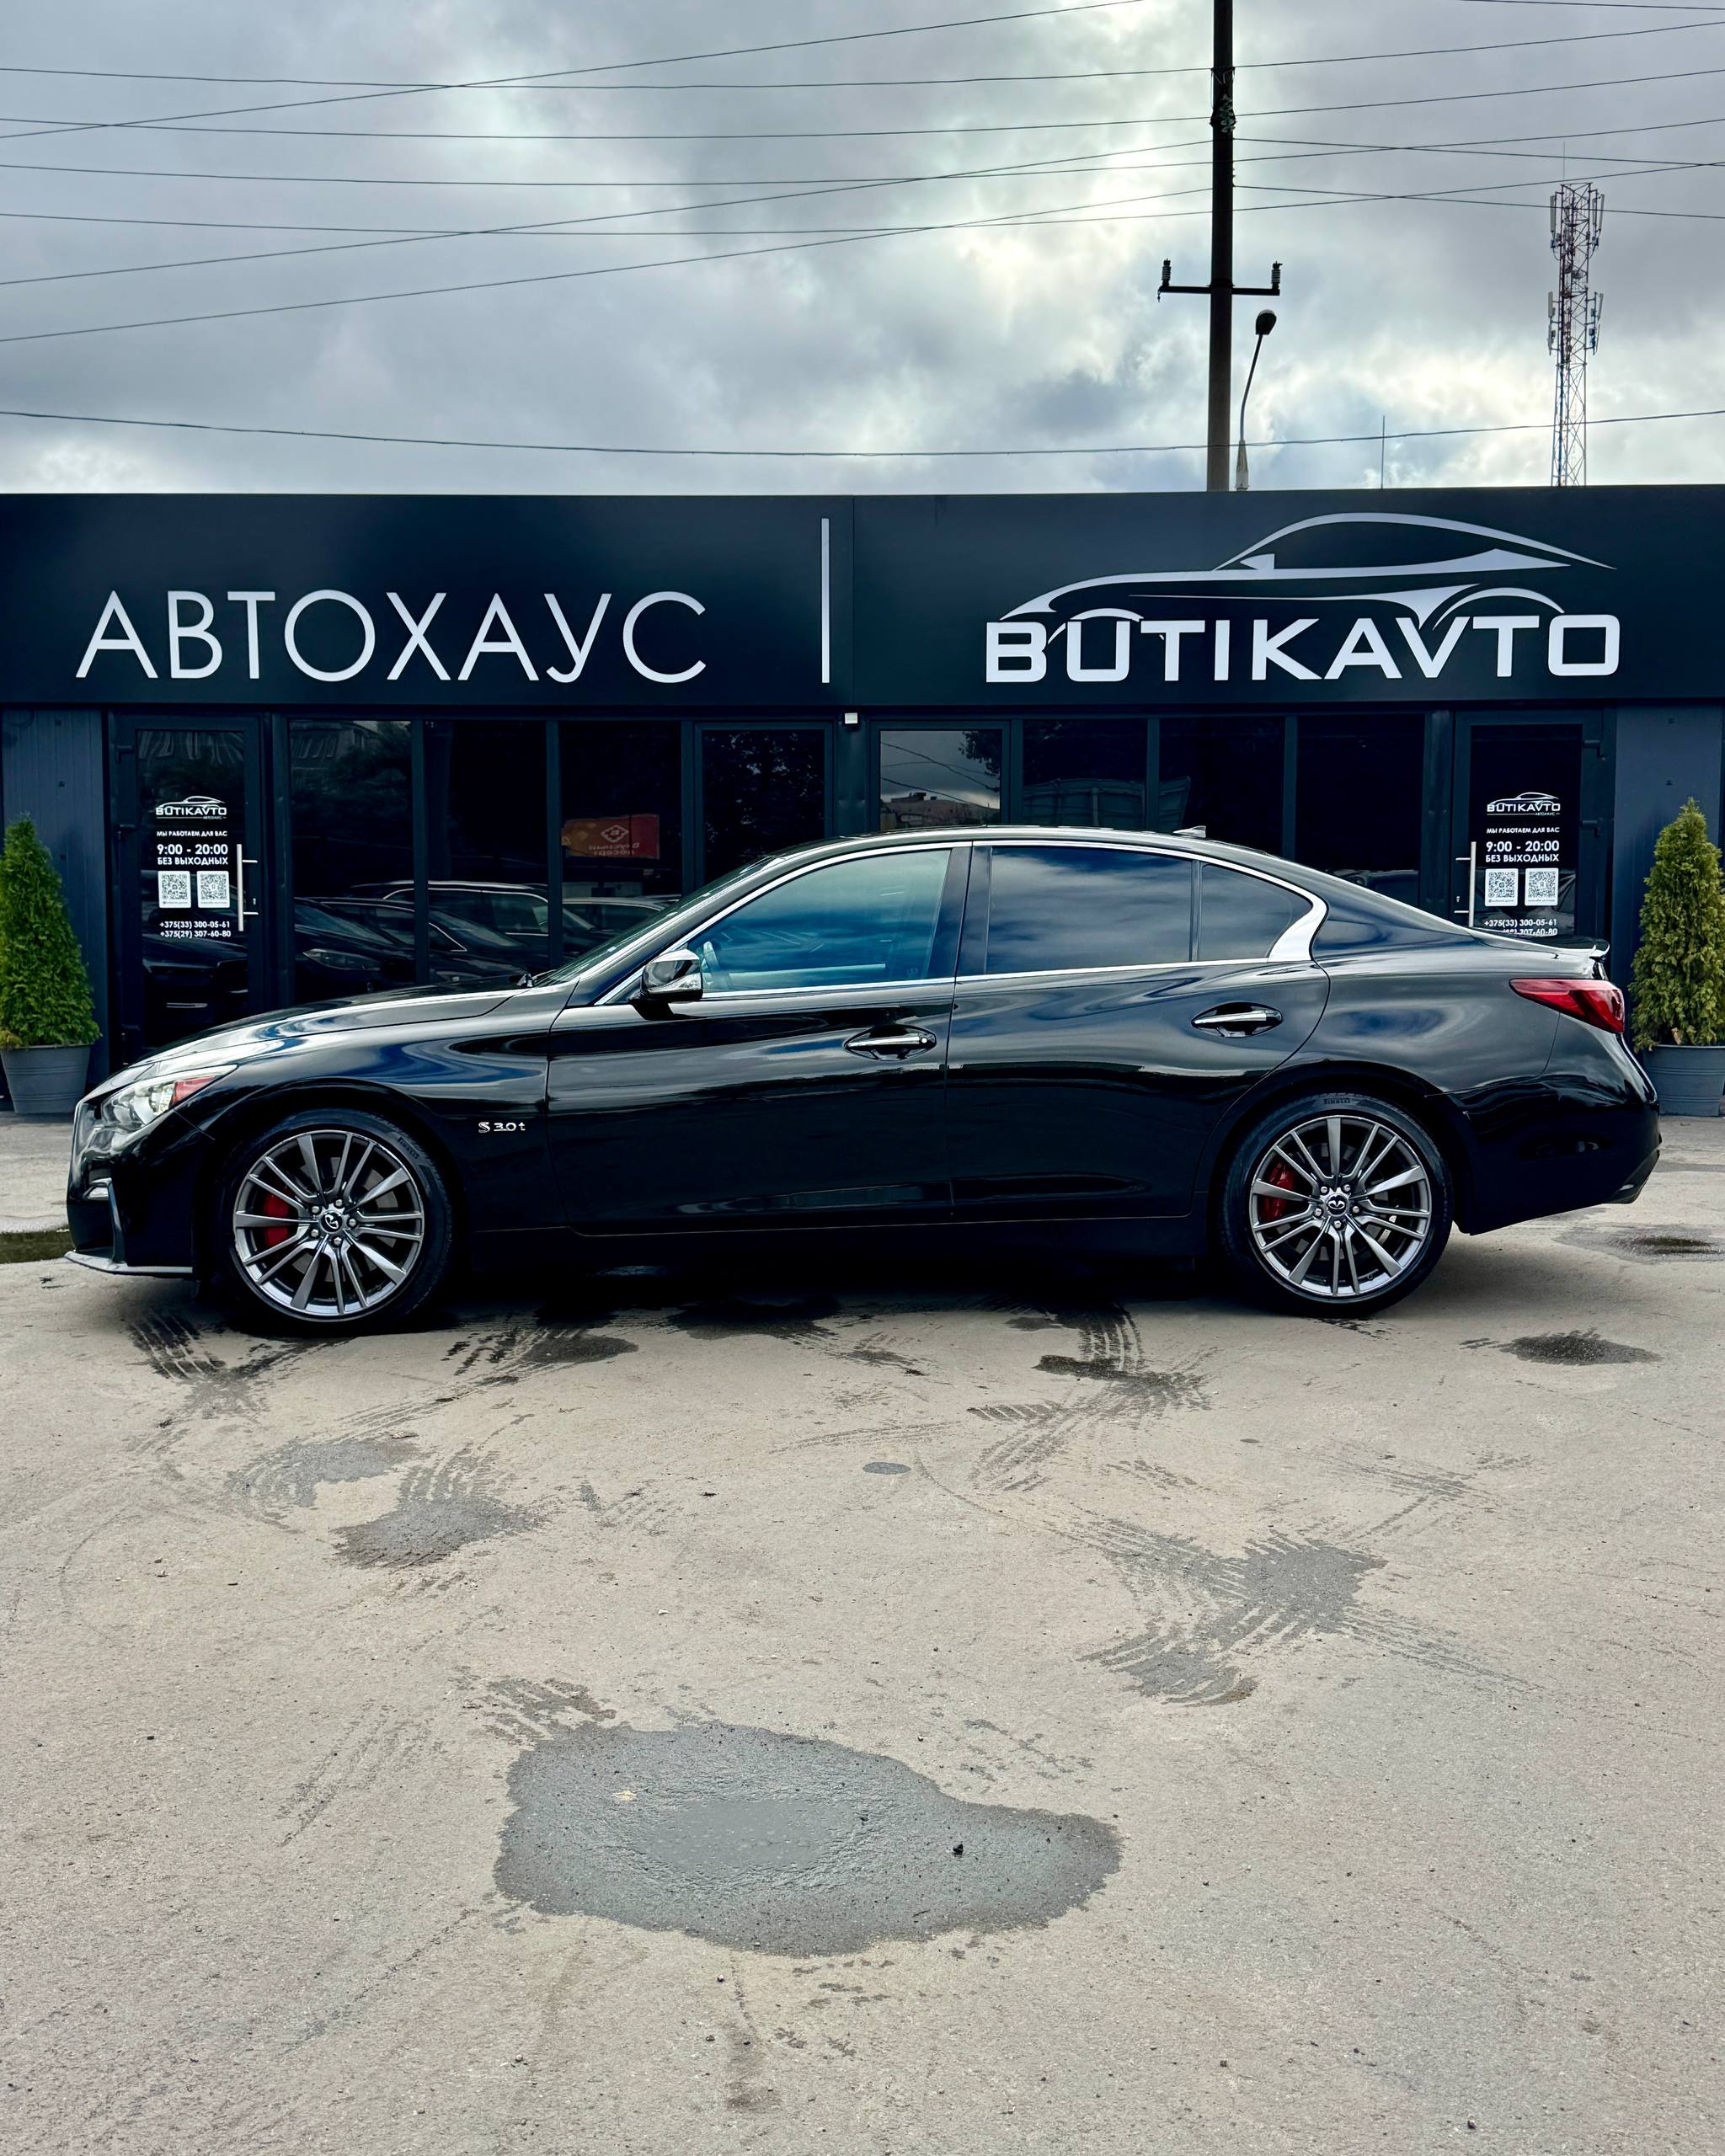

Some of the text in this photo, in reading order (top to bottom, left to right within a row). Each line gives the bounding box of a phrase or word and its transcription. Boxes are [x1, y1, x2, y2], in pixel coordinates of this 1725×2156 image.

[76, 590, 707, 683] АВТОХАУС
[986, 614, 1621, 683] BUTIKAVTO
[156, 807, 227, 815] BUTIKAVTO
[1487, 803, 1561, 812] BUTIKAVTO
[157, 844, 183, 855] 9:00
[195, 844, 228, 855] 20:00
[1486, 841, 1513, 852] 9:00
[1525, 841, 1559, 851] 20:00
[158, 857, 228, 866] БЕЗ ВЫХОДНЫХ
[1485, 854, 1559, 862] БЕЗ ВЫХОДНЫХ
[159, 921, 192, 929] +375(33)
[1484, 919, 1518, 927] +375(33)
[160, 930, 192, 939] +375(29)
